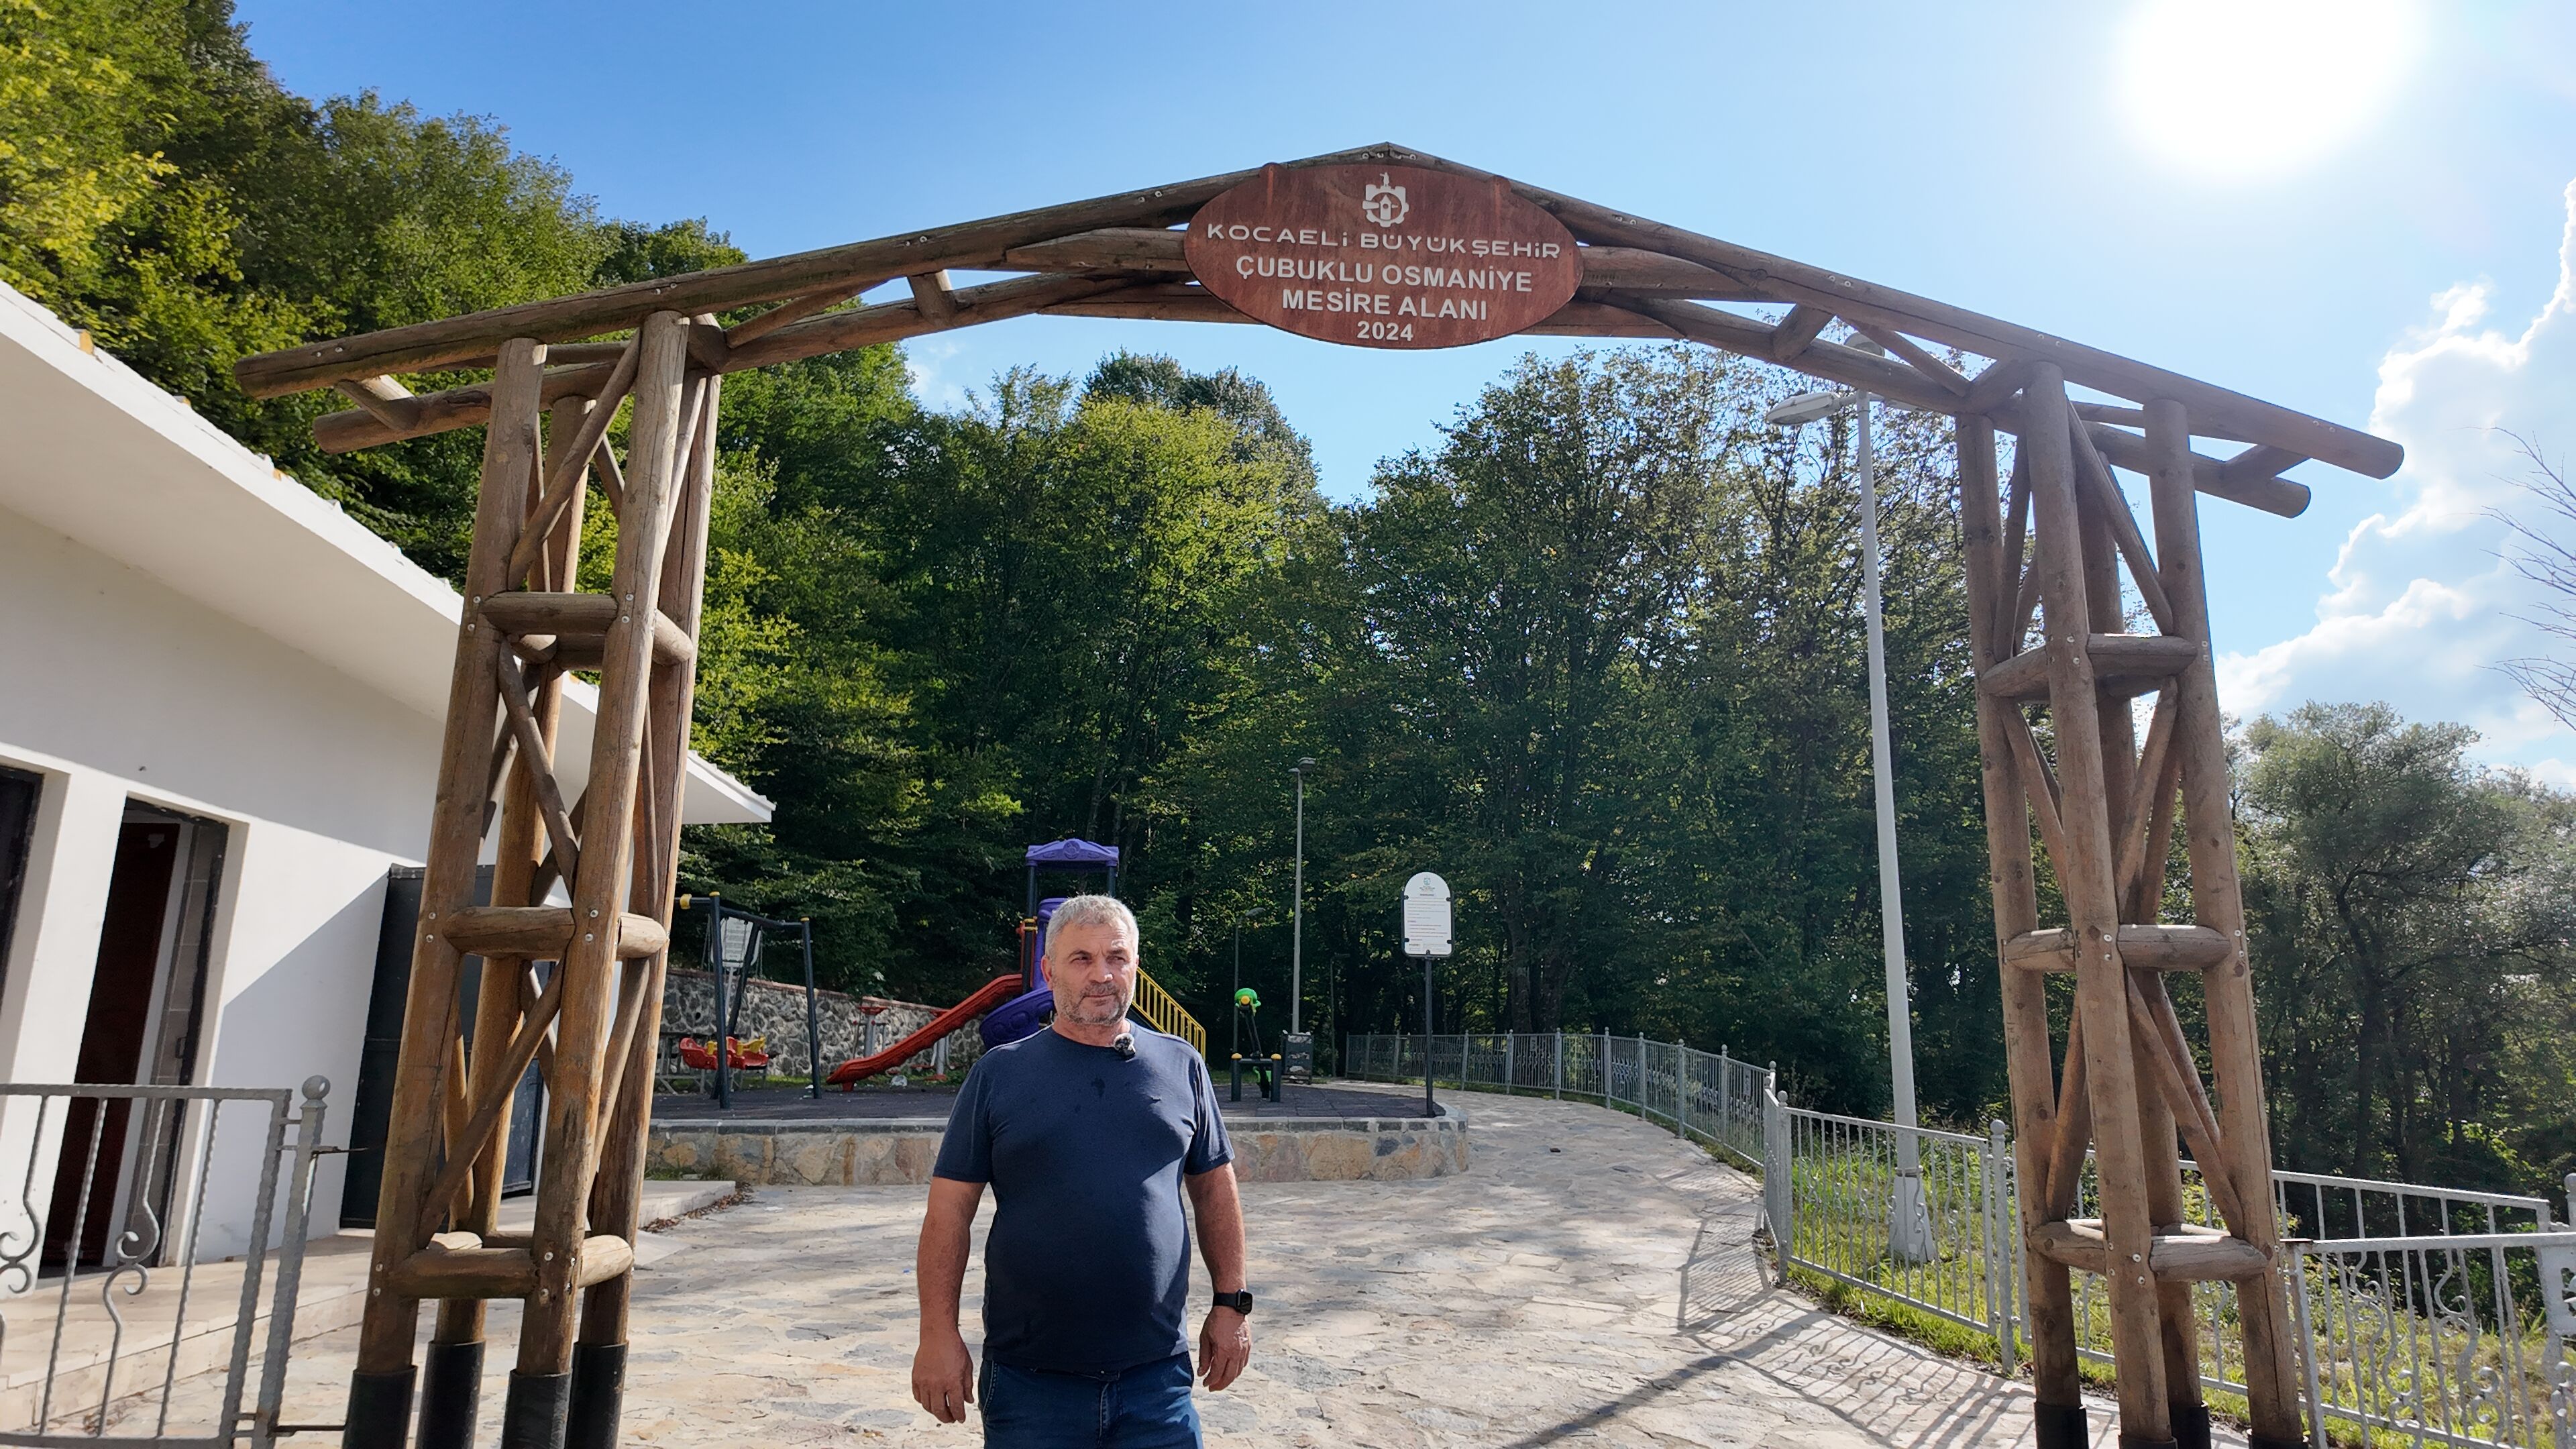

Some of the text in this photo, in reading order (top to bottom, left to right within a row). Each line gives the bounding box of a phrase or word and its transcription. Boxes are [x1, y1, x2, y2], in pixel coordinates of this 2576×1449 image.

[1235, 256, 1532, 292] ÇUBUKLU OSMANİYE
[1282, 288, 1487, 321] MESİRE ALANI
[1356, 321, 1414, 341] 2024
